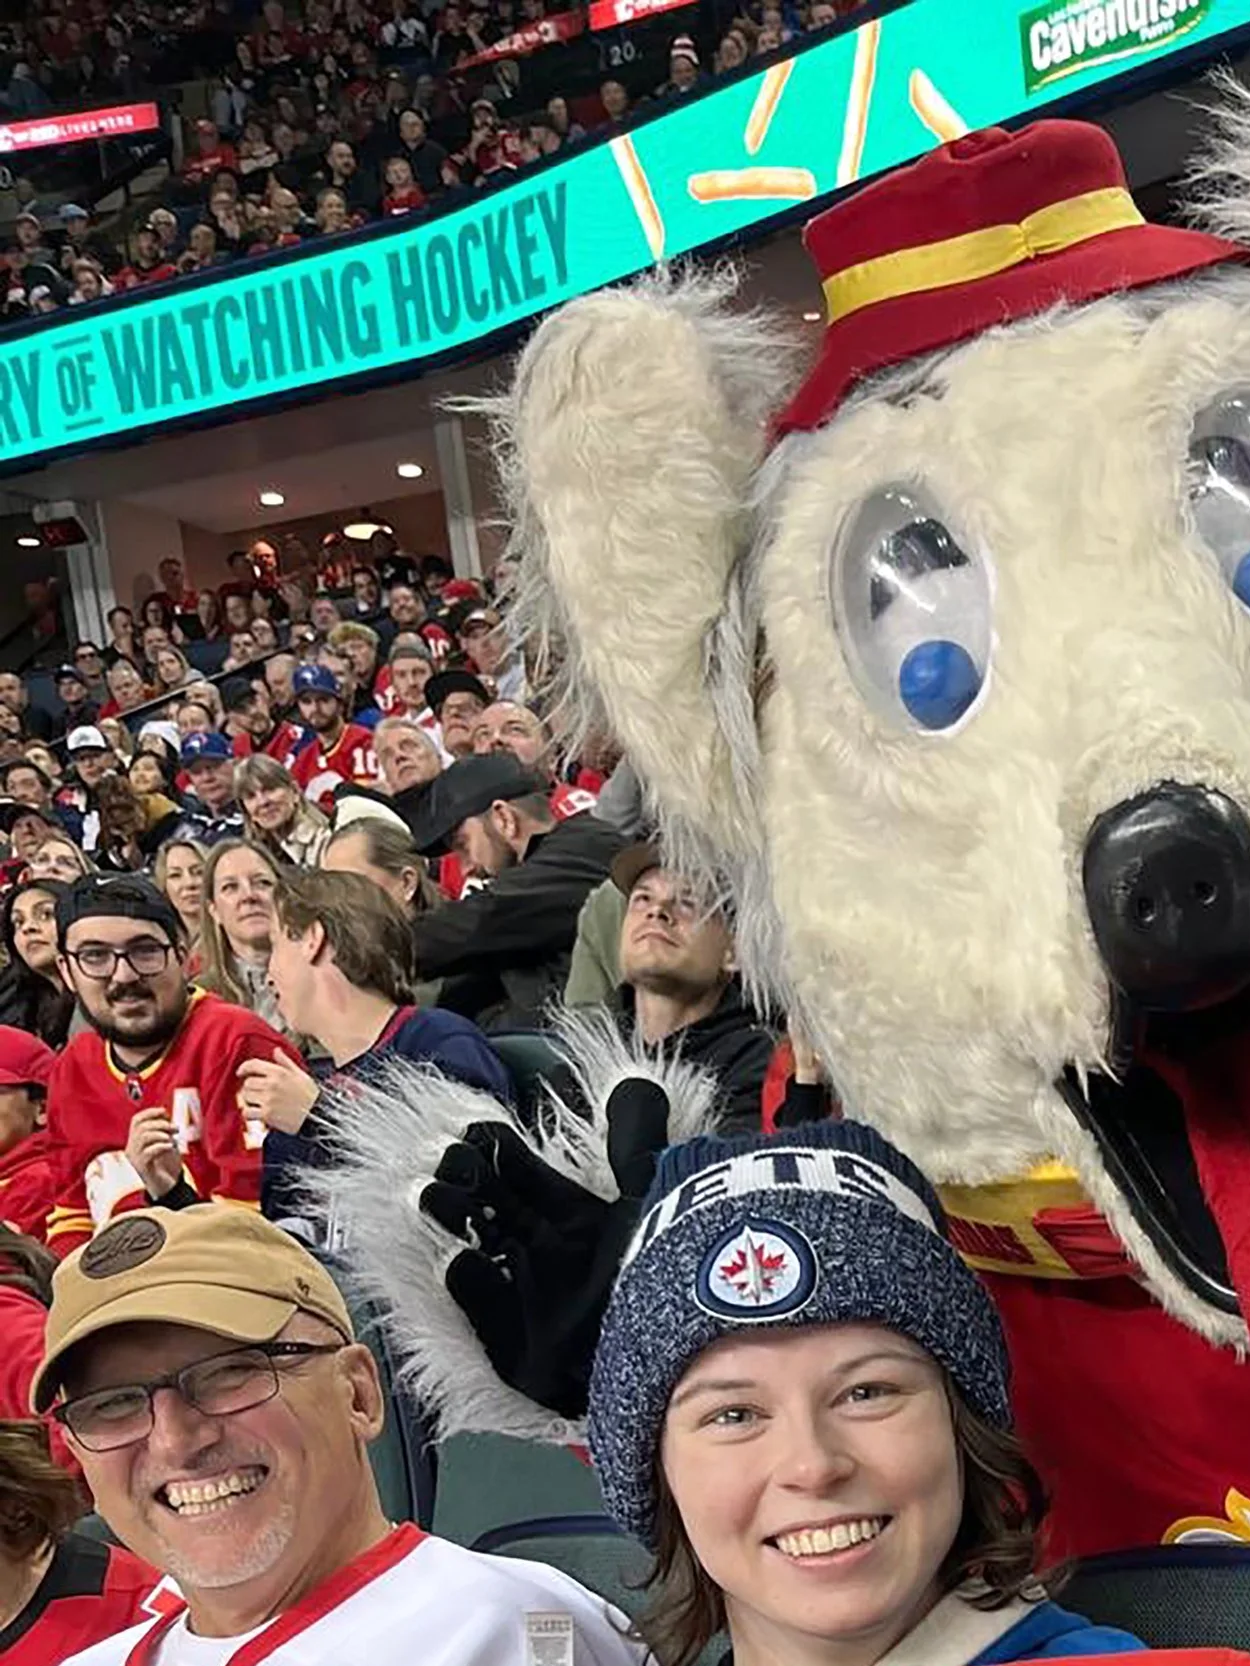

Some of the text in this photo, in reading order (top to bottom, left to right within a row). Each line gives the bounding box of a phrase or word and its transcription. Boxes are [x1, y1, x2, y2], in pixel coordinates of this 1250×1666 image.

[56, 352, 97, 417] OF
[101, 260, 383, 417] WATCHING
[385, 181, 568, 348] HOCKEY
